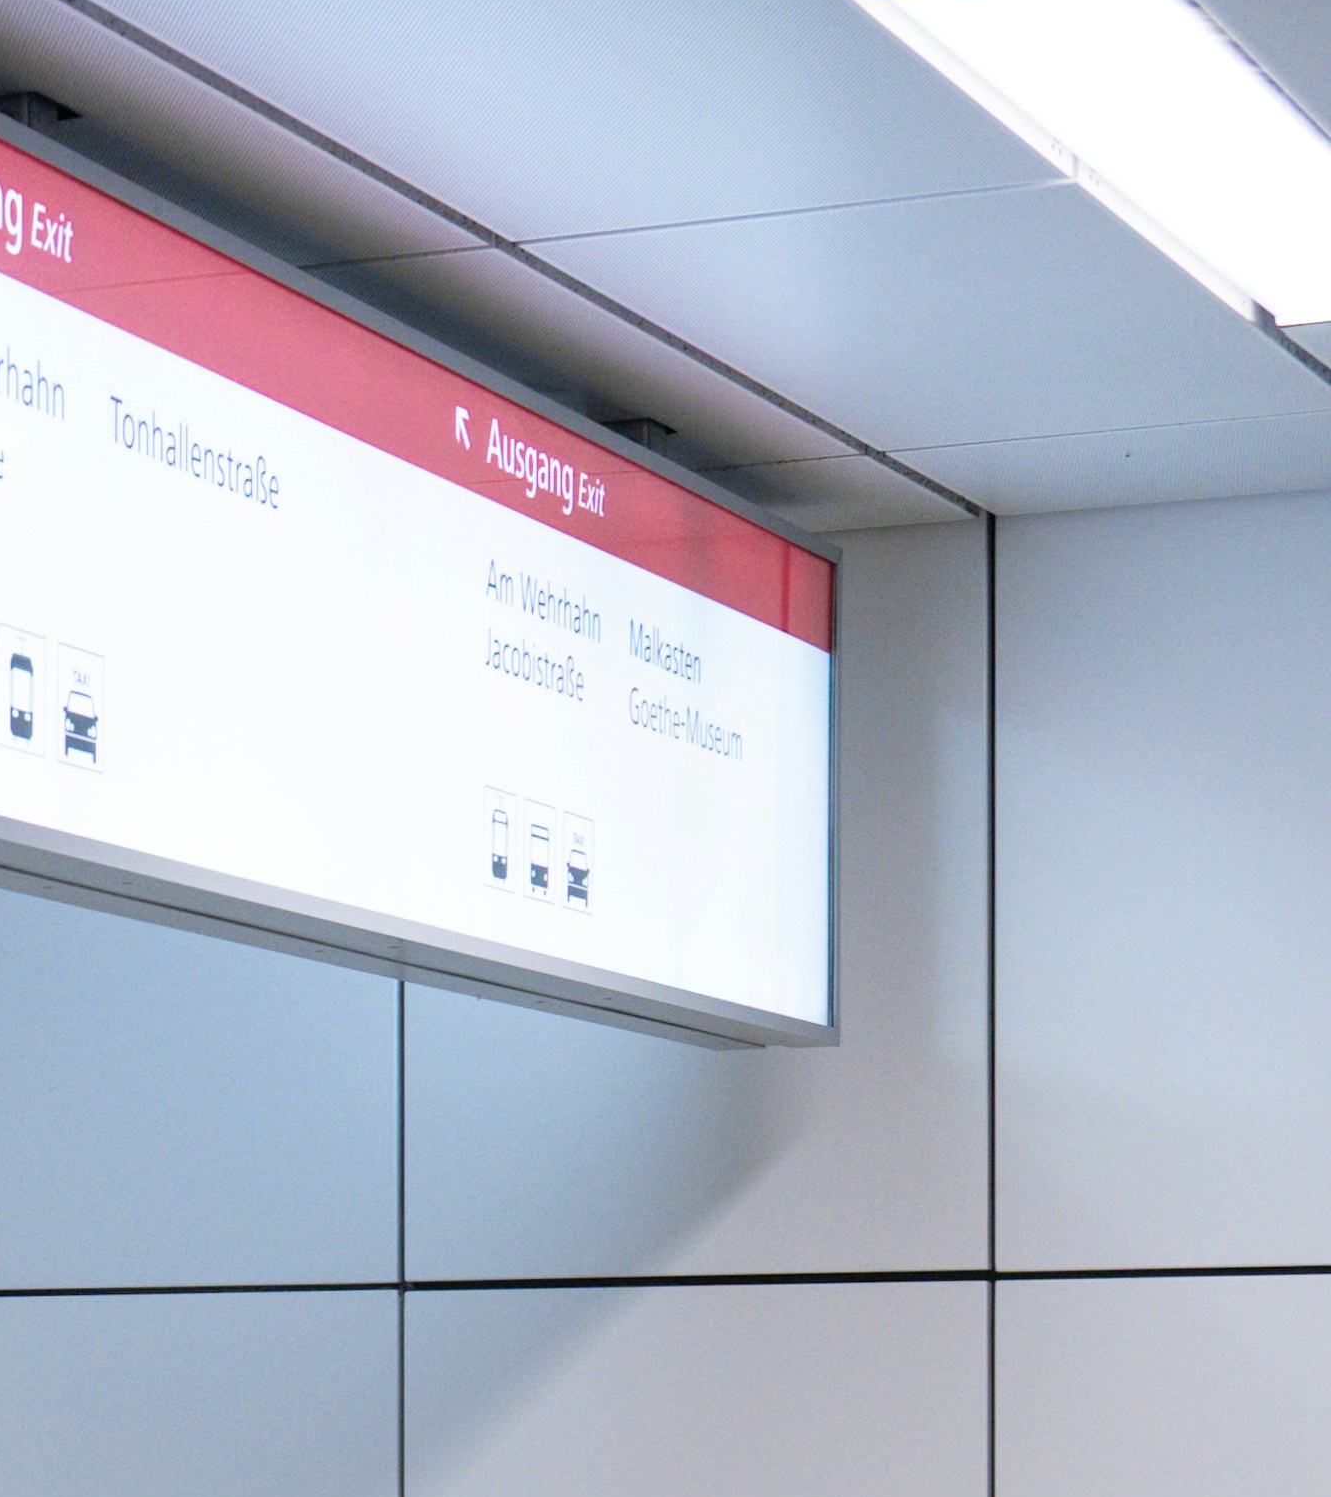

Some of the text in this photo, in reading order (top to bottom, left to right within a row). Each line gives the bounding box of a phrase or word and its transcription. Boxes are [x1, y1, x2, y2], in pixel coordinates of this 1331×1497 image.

[31, 204, 73, 262] Exit
[110, 396, 279, 509] Tonhallenstraße
[486, 418, 605, 516] Ausgang Exit
[486, 559, 601, 642] Am Wehrhahn
[486, 628, 584, 701] Jacobistraße
[629, 619, 701, 684] Malkasten
[629, 687, 742, 761] Goethe-Museum
